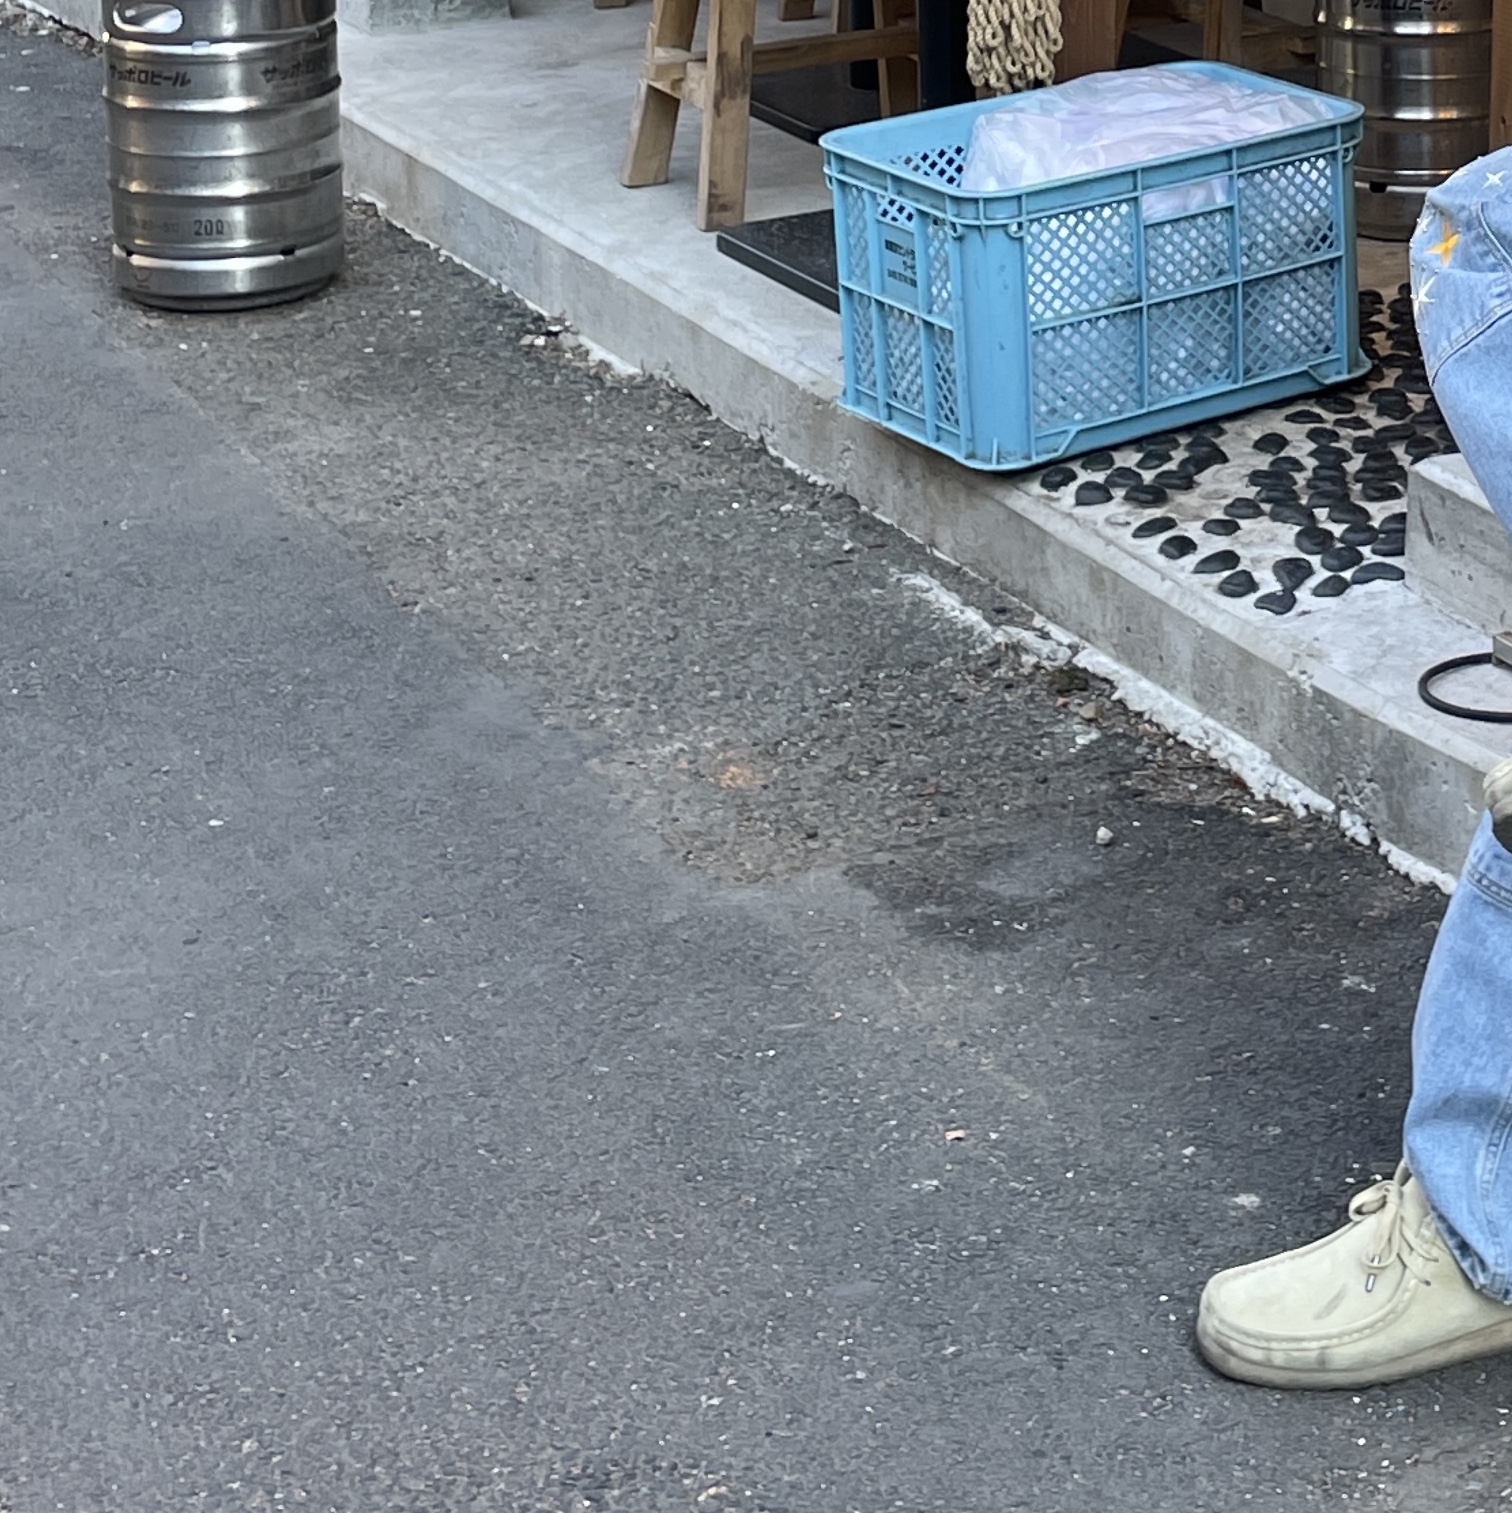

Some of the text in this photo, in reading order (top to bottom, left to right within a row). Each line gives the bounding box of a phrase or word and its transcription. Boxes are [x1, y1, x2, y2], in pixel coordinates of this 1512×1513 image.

[109, 63, 191, 88] サッポロビール
